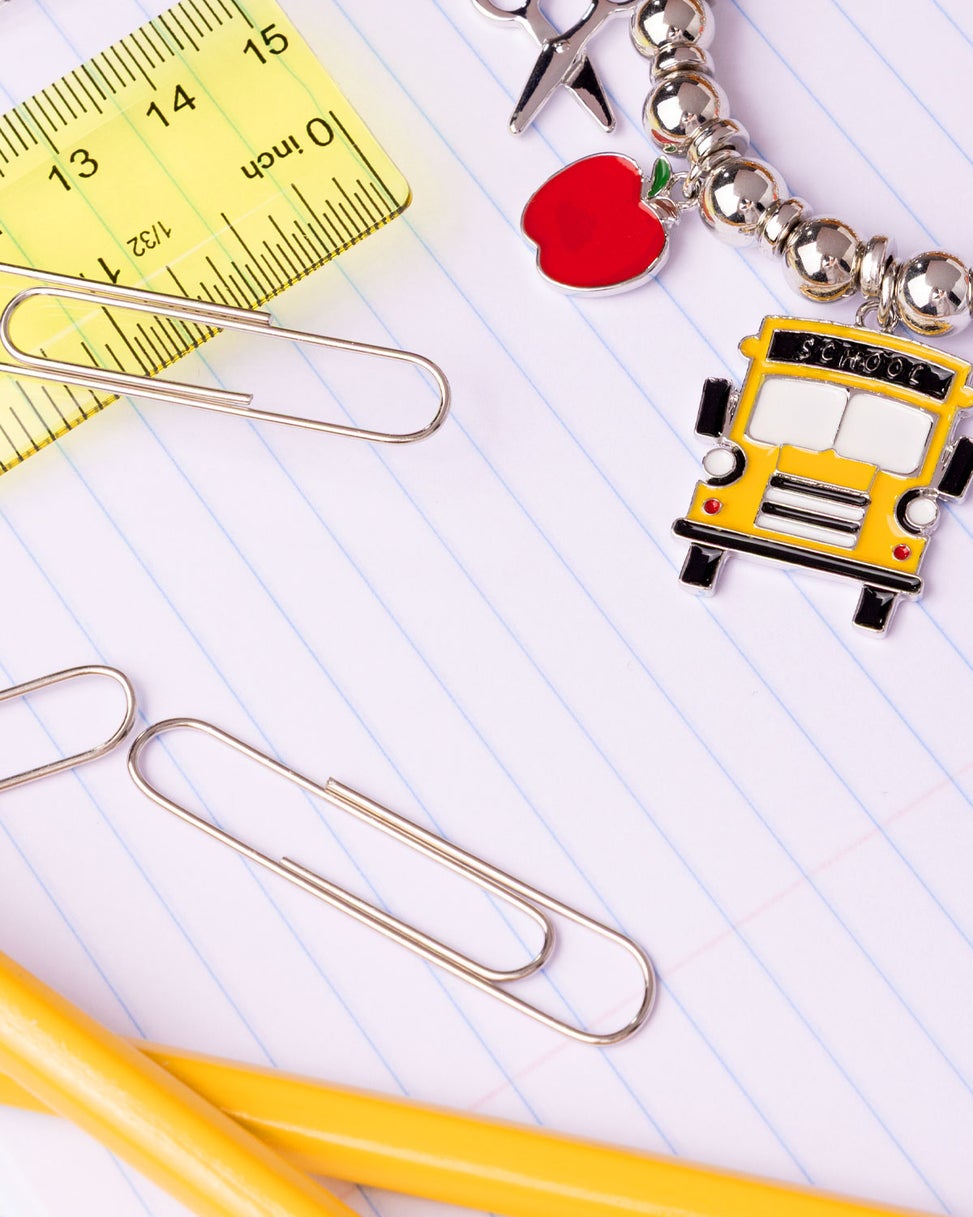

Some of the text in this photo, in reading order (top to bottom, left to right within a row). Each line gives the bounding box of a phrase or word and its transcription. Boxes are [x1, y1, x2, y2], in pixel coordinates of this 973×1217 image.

[48, 23, 289, 191] 13 14 15
[241, 117, 334, 180] 0 inch
[126, 221, 172, 257] 1/32
[97, 257, 121, 284] 1
[795, 337, 925, 385] SCHOOL
